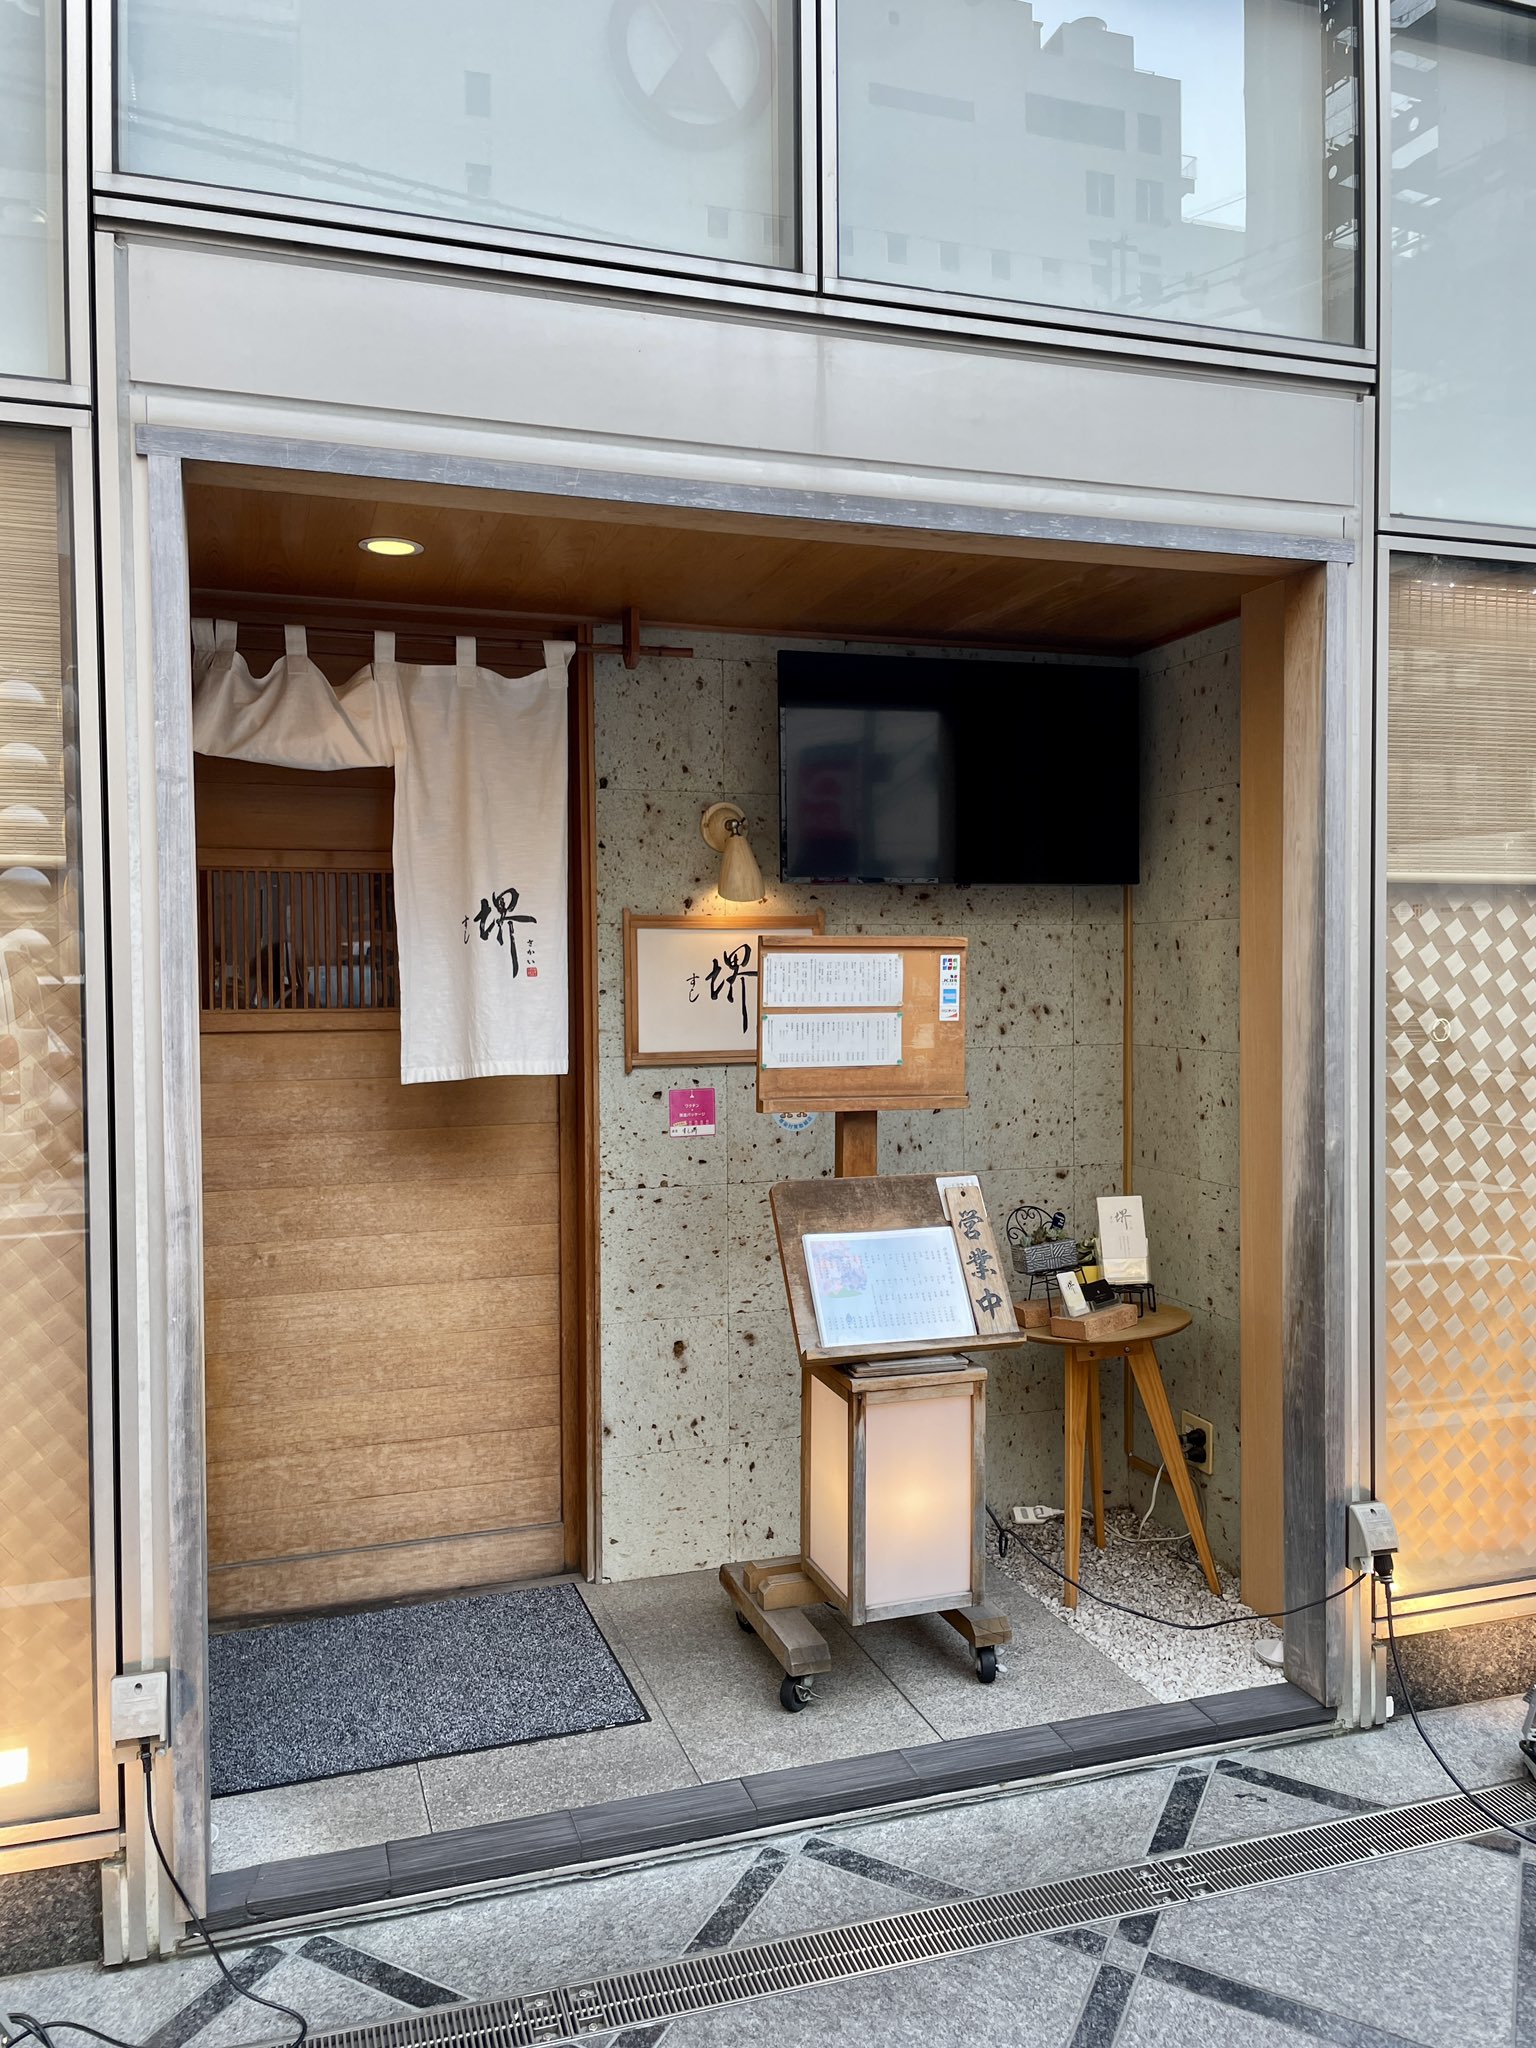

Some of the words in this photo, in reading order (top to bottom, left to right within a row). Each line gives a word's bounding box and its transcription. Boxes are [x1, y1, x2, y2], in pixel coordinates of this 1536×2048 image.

[461, 915, 470, 945] すし
[473, 887, 538, 979] 堺
[526, 939, 536, 965] さかい
[686, 972, 700, 1003] すし
[705, 943, 758, 1034] 堺
[957, 1209, 1004, 1320] 営業中
